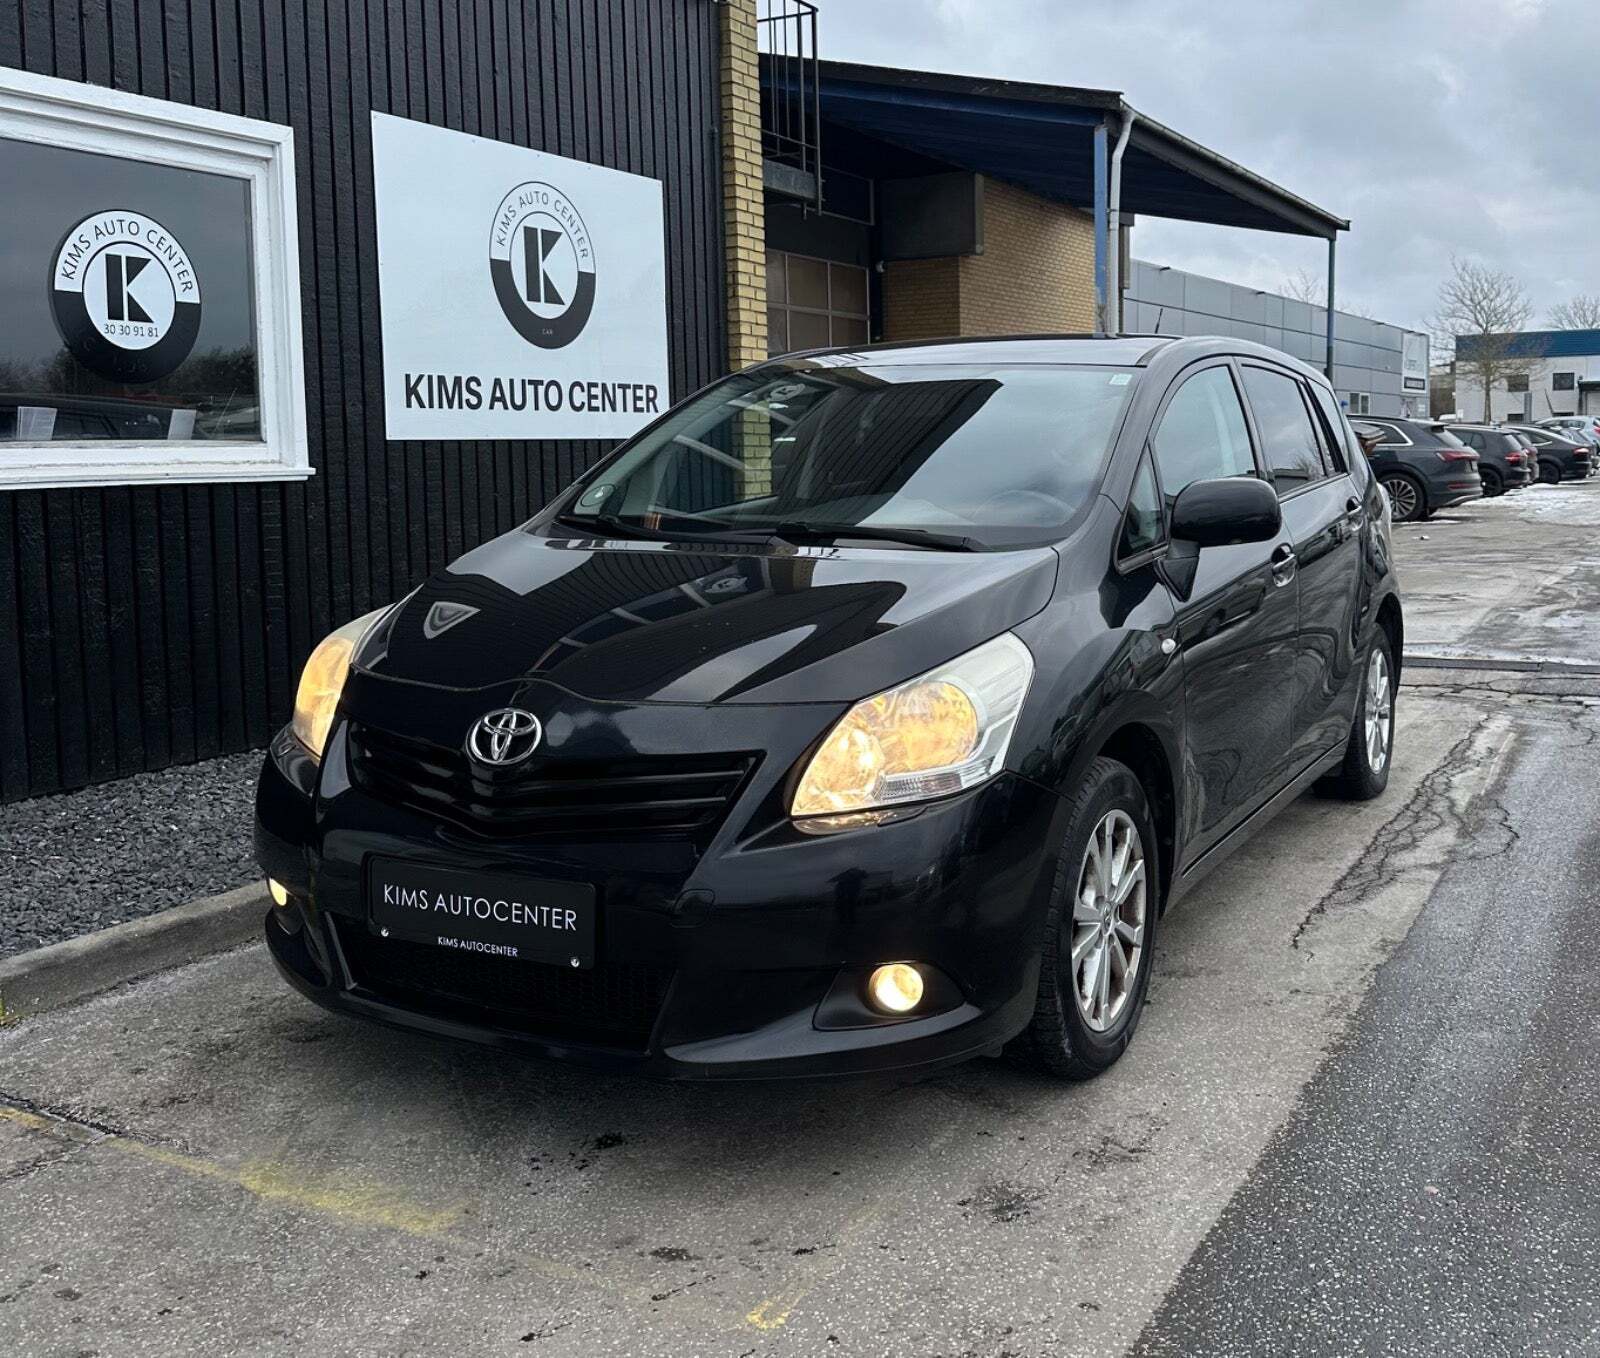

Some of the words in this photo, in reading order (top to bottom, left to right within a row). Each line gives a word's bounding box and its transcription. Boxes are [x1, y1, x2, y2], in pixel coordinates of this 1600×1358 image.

[496, 205, 517, 247] KIMS
[519, 191, 549, 208] AUTO
[554, 199, 589, 258] CENTER
[62, 233, 91, 280] KIMS
[94, 219, 140, 240] AUTO
[147, 229, 192, 293] CENTER
[523, 226, 565, 306] K
[105, 253, 154, 323] K
[104, 323, 116, 335] 30
[118, 324, 131, 336] 30
[133, 325, 144, 337] 91
[148, 326, 159, 338] 81
[404, 373, 483, 410] KIMS
[489, 377, 563, 412] AUTO
[569, 380, 659, 413] CENTER
[383, 884, 428, 911] KIMS
[434, 893, 577, 931] AUTOCENTER
[438, 936, 458, 949] KIMS
[460, 940, 518, 957] AUTOCENTER
